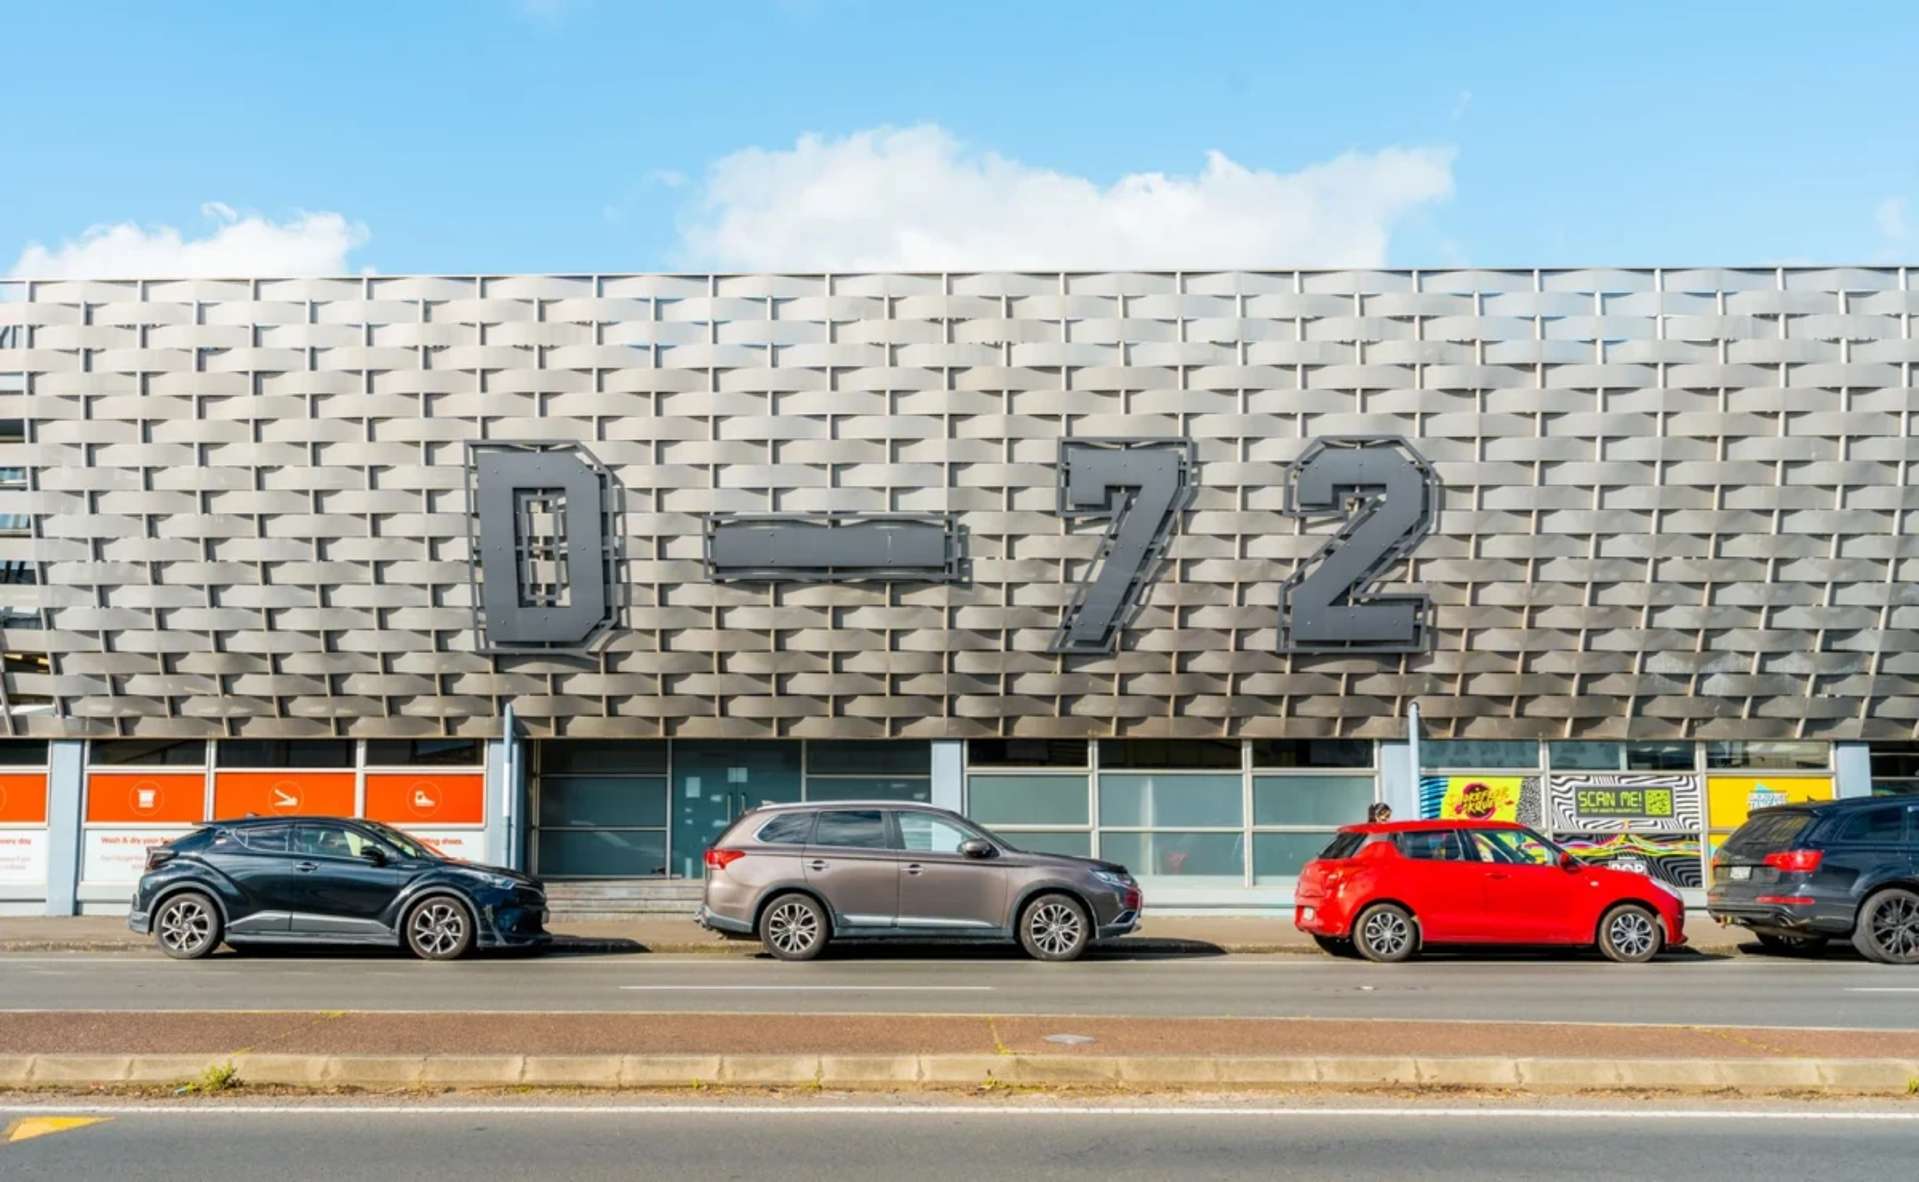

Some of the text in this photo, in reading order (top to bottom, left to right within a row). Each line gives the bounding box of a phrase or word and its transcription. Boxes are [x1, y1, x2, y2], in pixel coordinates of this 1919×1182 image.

[1578, 791, 1642, 807] SCAN ME!
[101, 836, 121, 844] Wash
